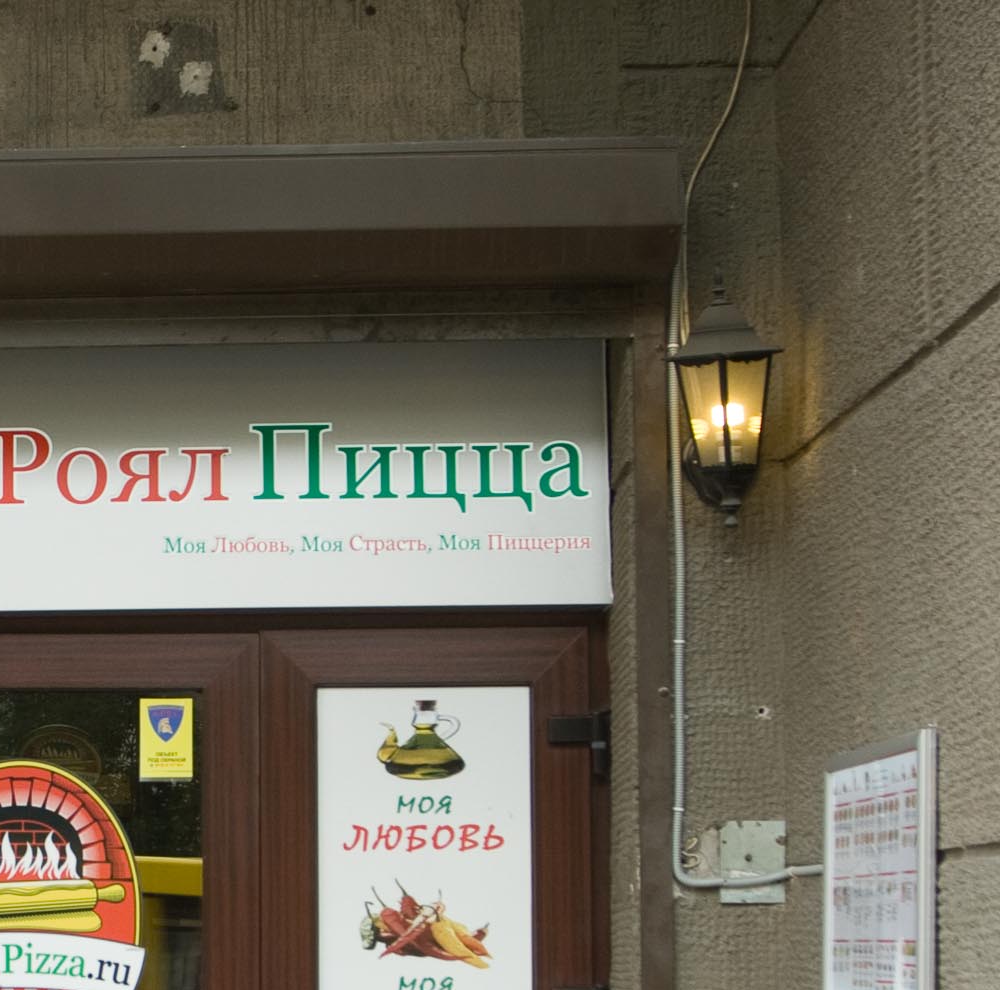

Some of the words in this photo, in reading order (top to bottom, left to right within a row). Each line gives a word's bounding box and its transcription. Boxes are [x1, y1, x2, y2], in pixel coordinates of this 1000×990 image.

[251, 424, 590, 513] Пицца
[163, 536, 206, 554] Моя
[211, 536, 295, 556] Любовь,
[301, 535, 343, 553] Моя
[349, 535, 432, 556] Страсть,
[439, 534, 481, 551] Моя
[488, 534, 591, 555] Пиццерия
[343, 824, 505, 853] ЛЮБОВЬ
